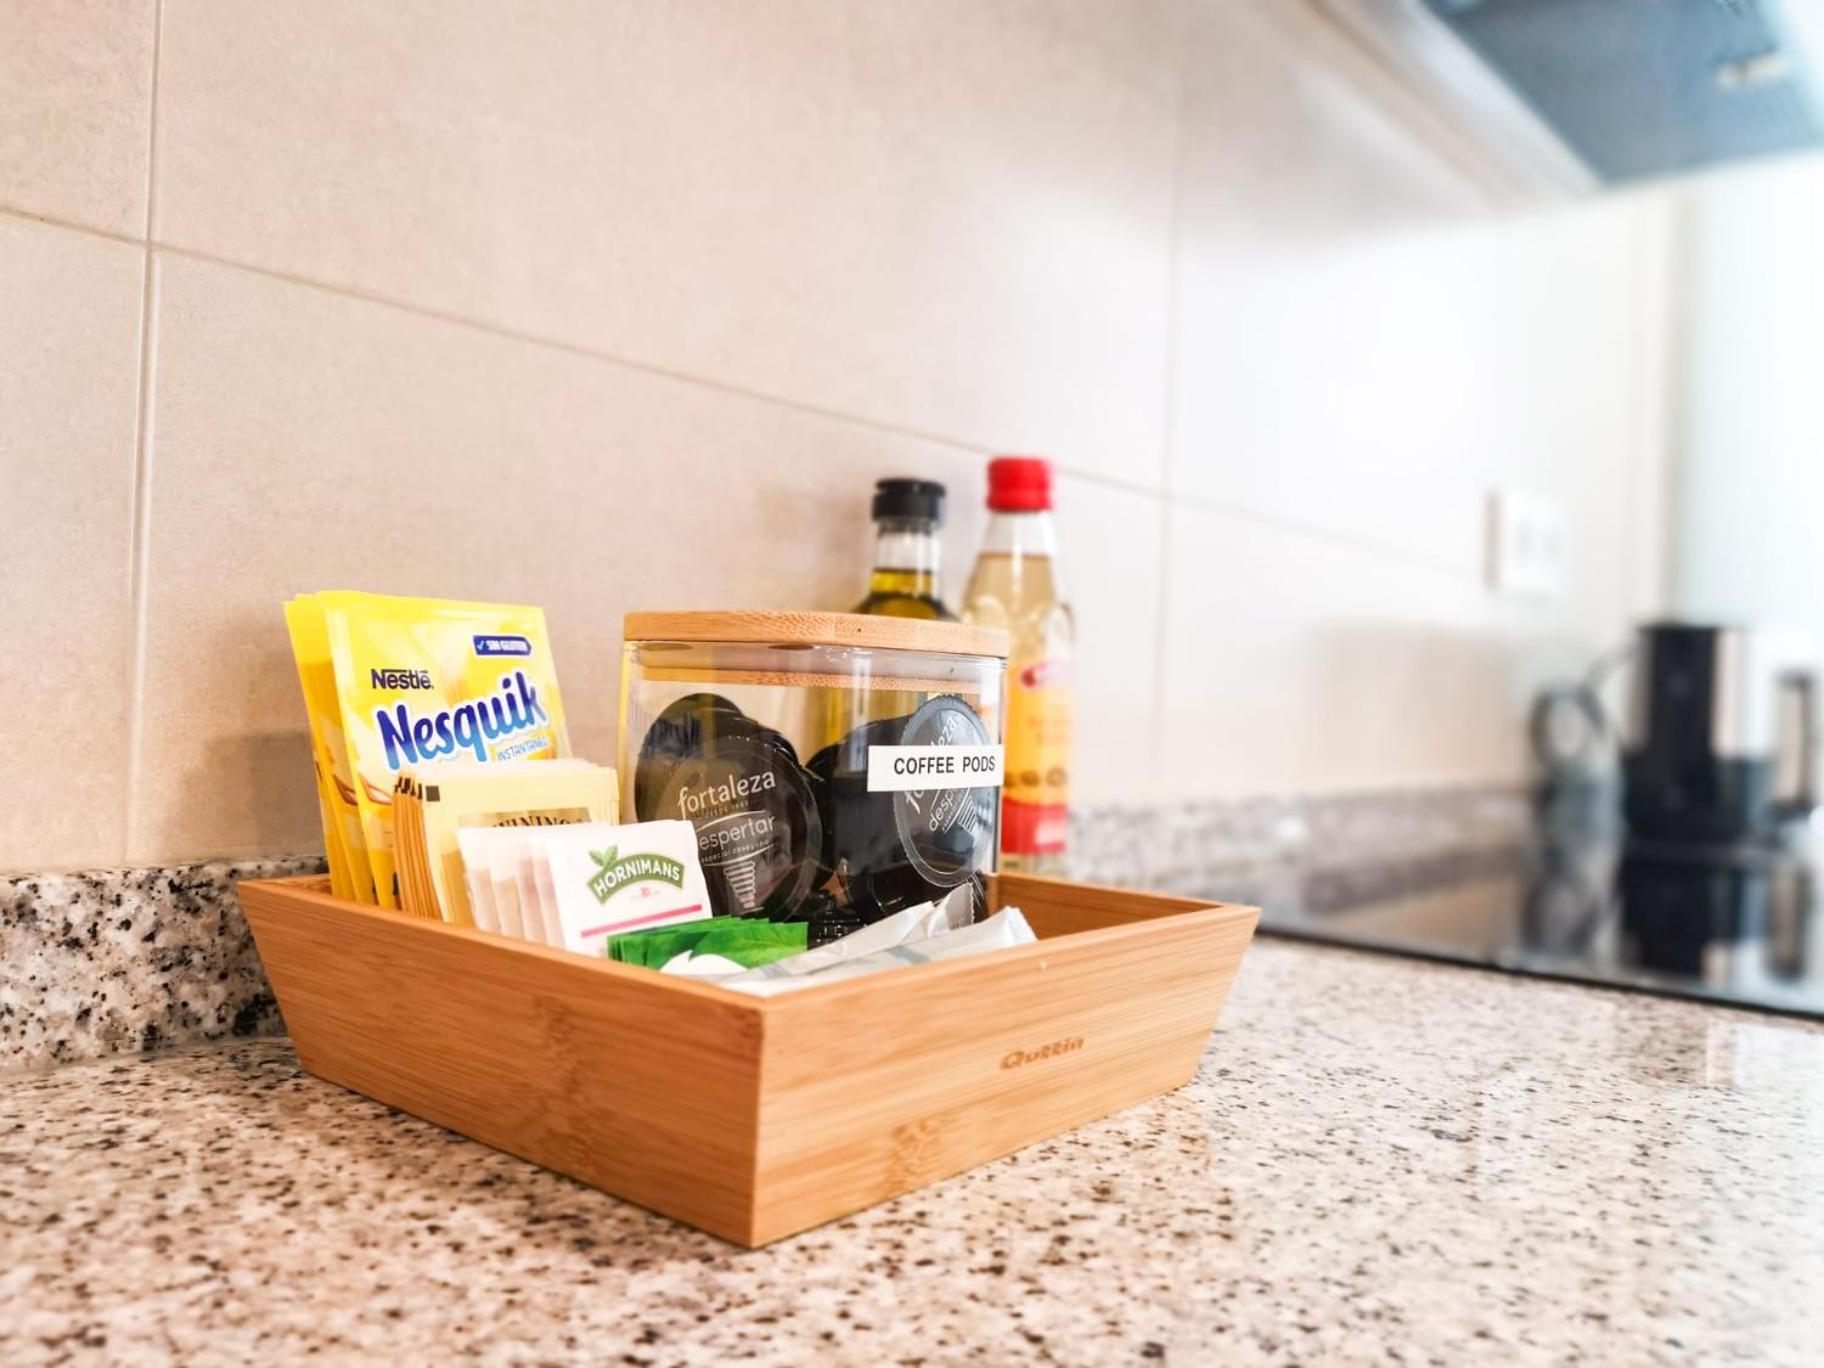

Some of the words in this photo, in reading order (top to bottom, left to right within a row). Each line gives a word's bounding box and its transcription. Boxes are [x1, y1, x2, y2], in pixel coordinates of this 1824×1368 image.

[376, 671, 547, 770] Nesquik
[894, 757, 955, 775] COFFEE
[963, 755, 996, 773] PODS
[677, 770, 776, 820] fortaleza
[700, 815, 776, 850] espertar
[593, 857, 681, 897] HORNIMANS
